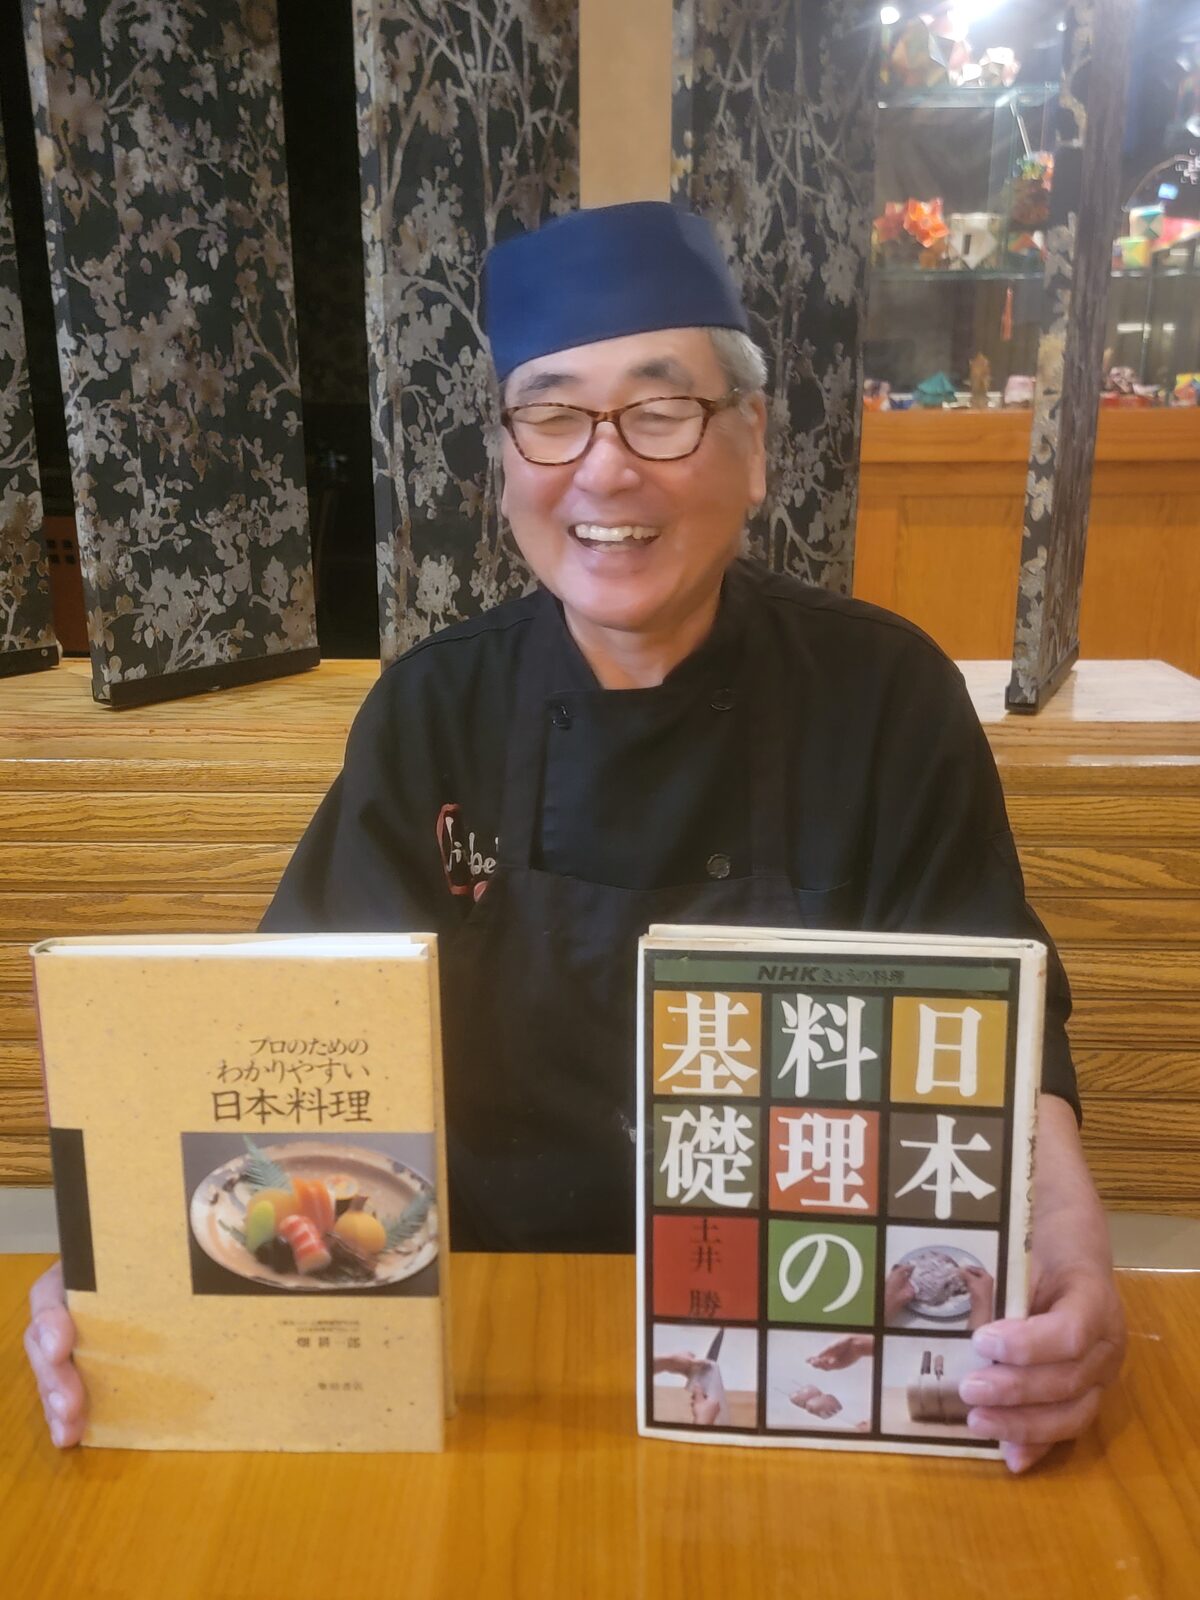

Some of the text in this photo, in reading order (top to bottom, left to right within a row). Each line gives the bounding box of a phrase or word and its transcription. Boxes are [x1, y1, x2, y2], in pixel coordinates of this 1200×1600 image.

[757, 965, 820, 982] NHK
[249, 1037, 369, 1056] プロのための
[216, 1058, 371, 1084] わかりやすい
[211, 1087, 373, 1126] 日本料理
[658, 992, 758, 1209] 基礎
[894, 1003, 996, 1219] 日本
